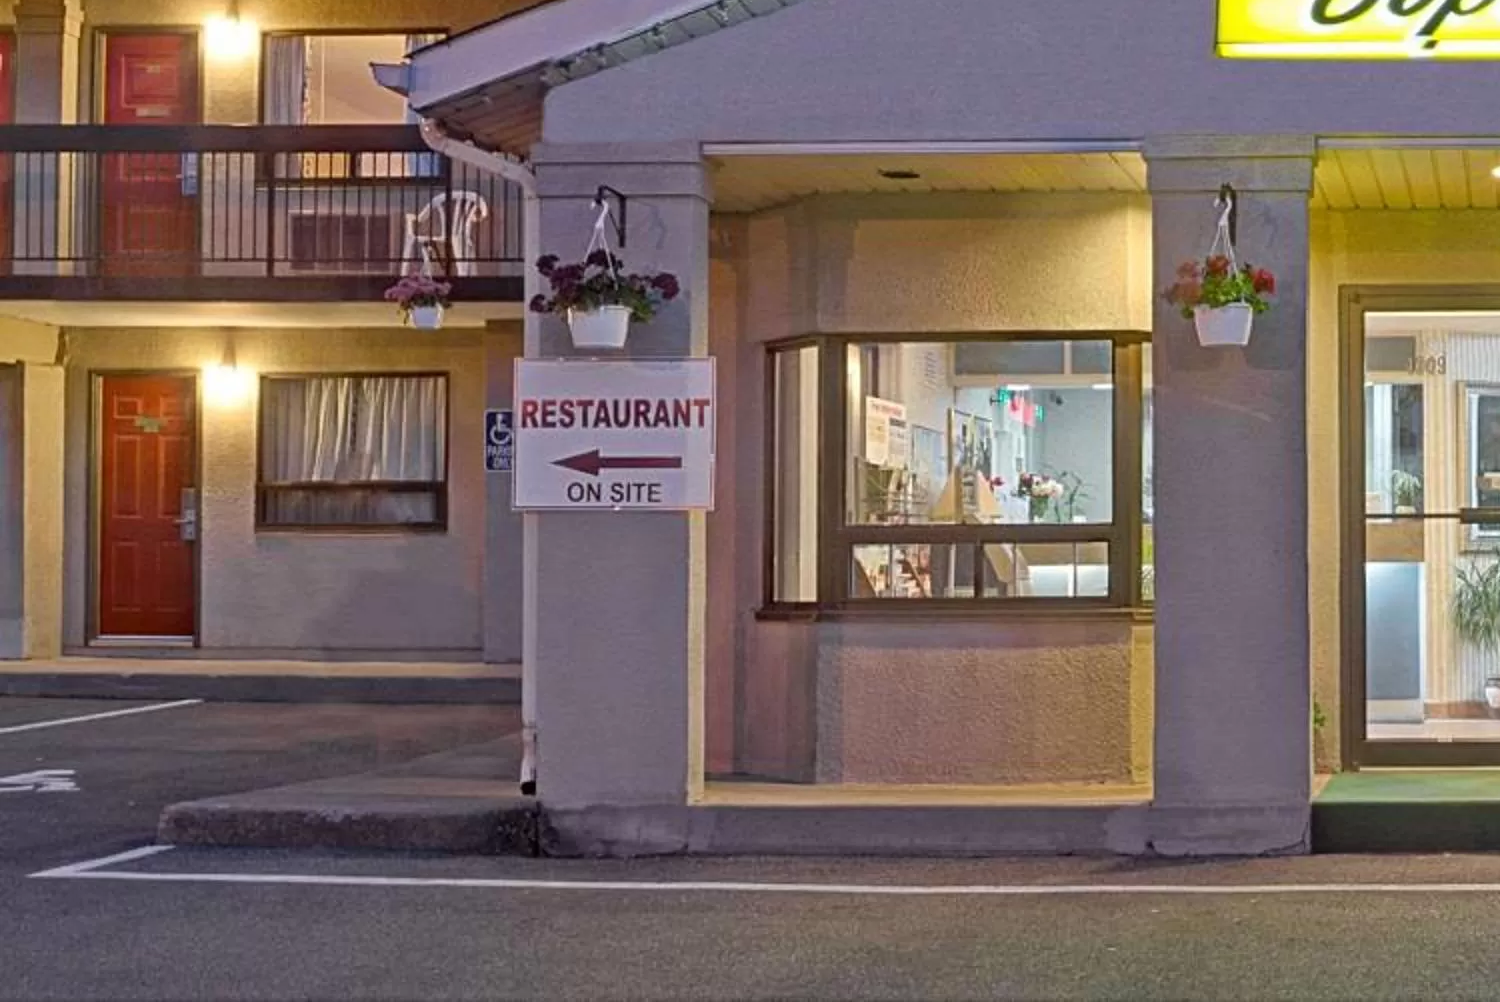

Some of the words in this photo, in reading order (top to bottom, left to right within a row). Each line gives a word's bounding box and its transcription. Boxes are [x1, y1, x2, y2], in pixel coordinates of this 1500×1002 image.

[521, 399, 710, 428] RESTAURANT
[567, 482, 602, 503] ON
[610, 482, 662, 503] SITE
